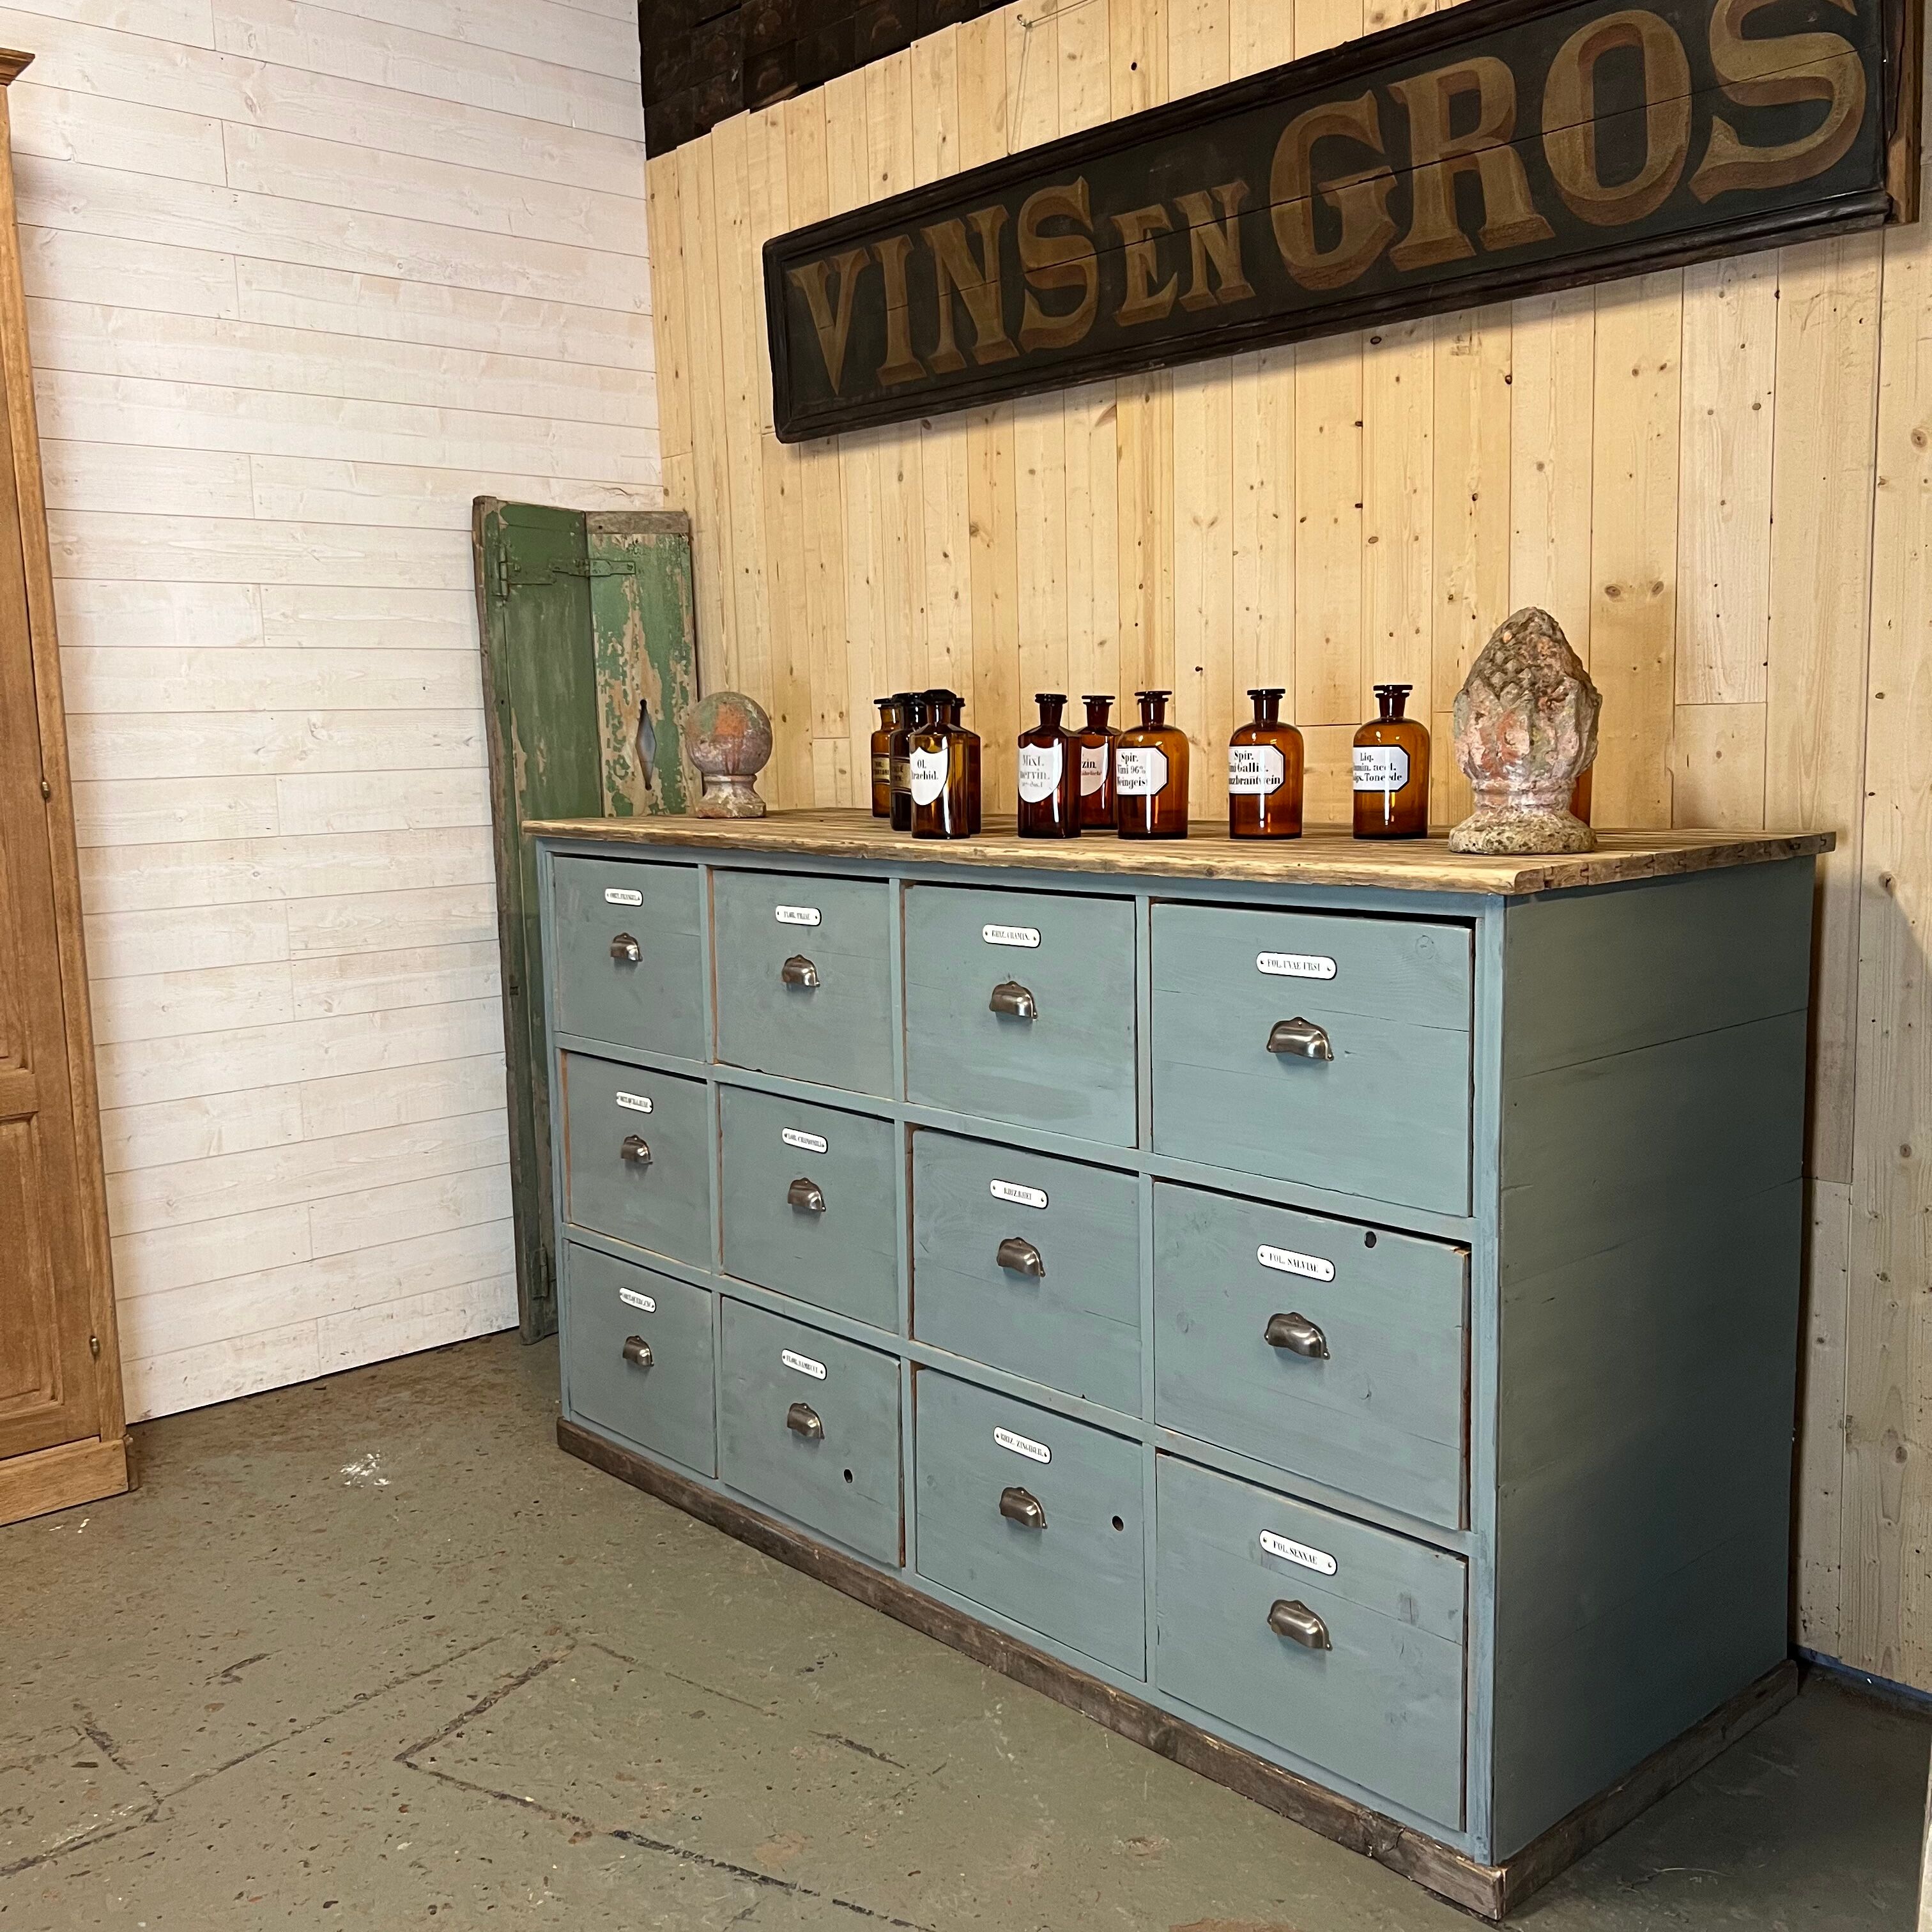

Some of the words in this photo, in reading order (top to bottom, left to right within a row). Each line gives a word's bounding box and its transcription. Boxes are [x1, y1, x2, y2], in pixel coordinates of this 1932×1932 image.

[786, 175, 1100, 395] VINS
[1110, 180, 1257, 327] EN
[1270, 0, 1867, 291] GROS
[1121, 752, 1139, 765] Spir.
[1234, 750, 1254, 763] Spir.
[1360, 752, 1374, 763] Liq.
